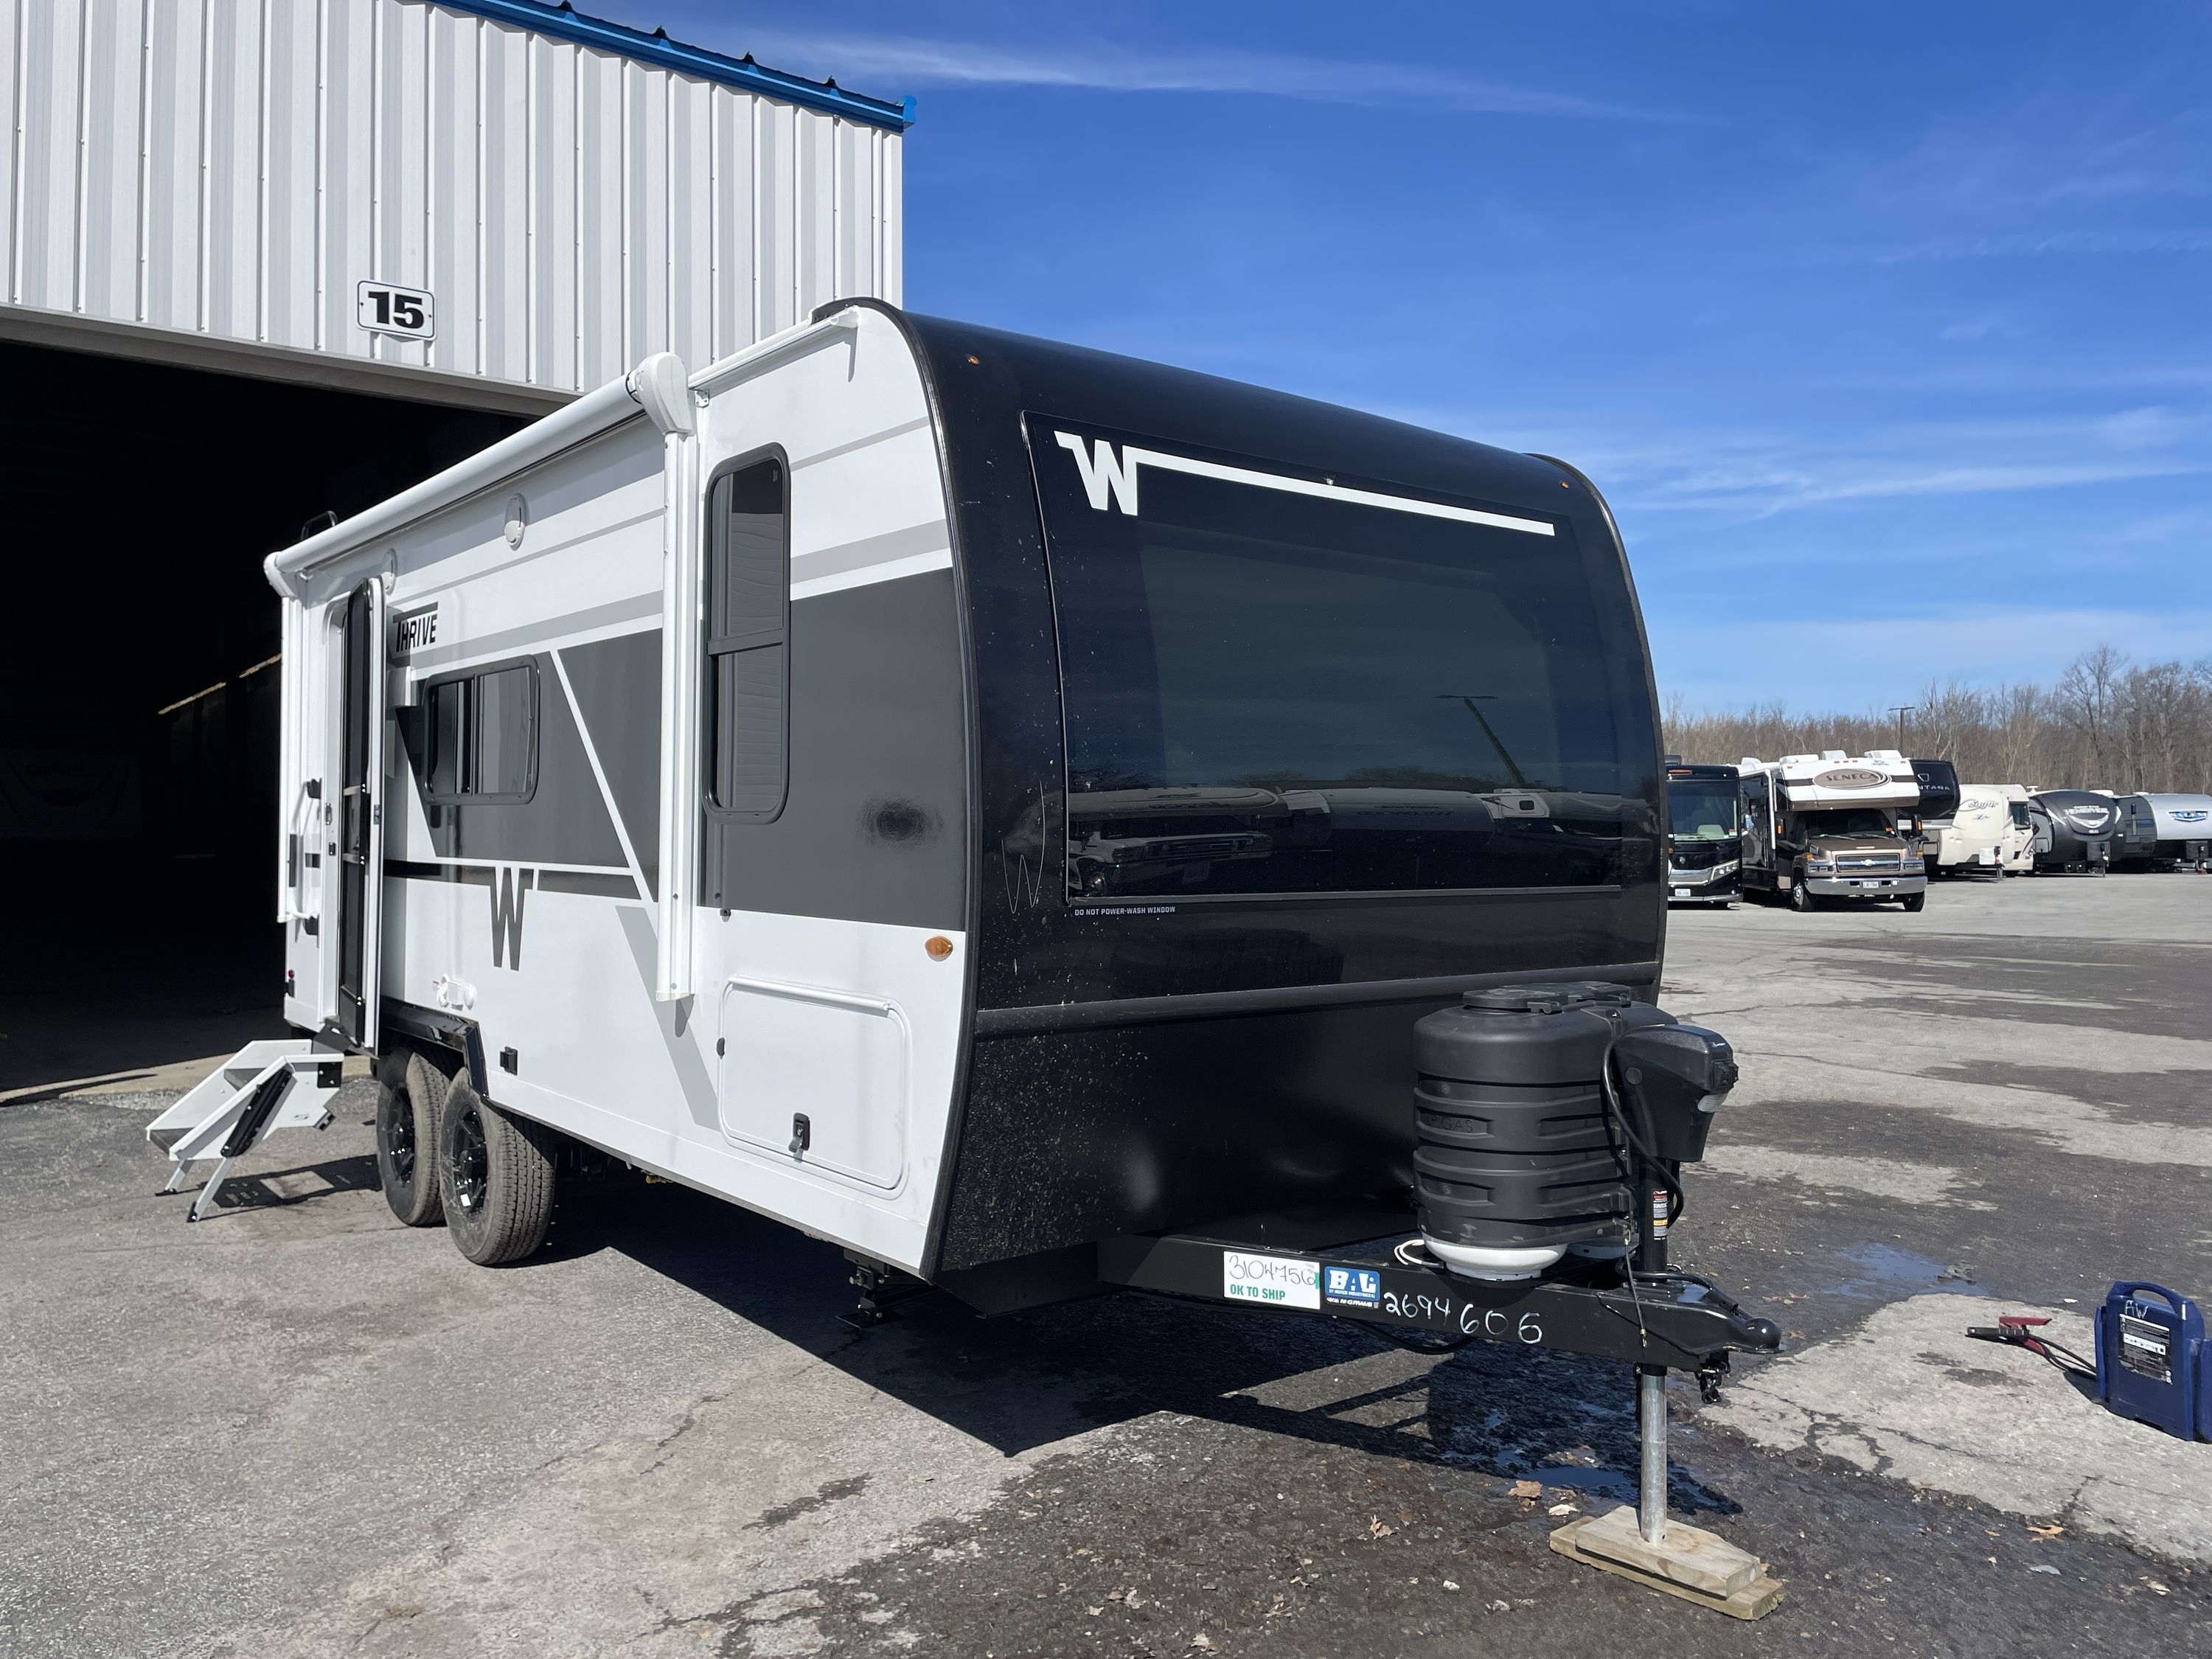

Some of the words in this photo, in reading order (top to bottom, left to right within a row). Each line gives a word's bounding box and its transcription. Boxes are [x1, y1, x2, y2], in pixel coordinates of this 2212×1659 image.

[367, 291, 425, 330] 15
[1054, 430, 1138, 516] W
[393, 601, 439, 653] THRIVE
[1826, 773, 1879, 782] SENECA
[490, 866, 535, 972] W
[1101, 907, 1146, 915] POWER-WASH
[1441, 1116, 1473, 1133] GAS
[1229, 1254, 1316, 1286] 3104756
[1329, 1270, 1377, 1294] BAL
[1230, 1284, 1245, 1296] OK
[1246, 1286, 1259, 1298] TO
[1262, 1287, 1286, 1301] SHIP
